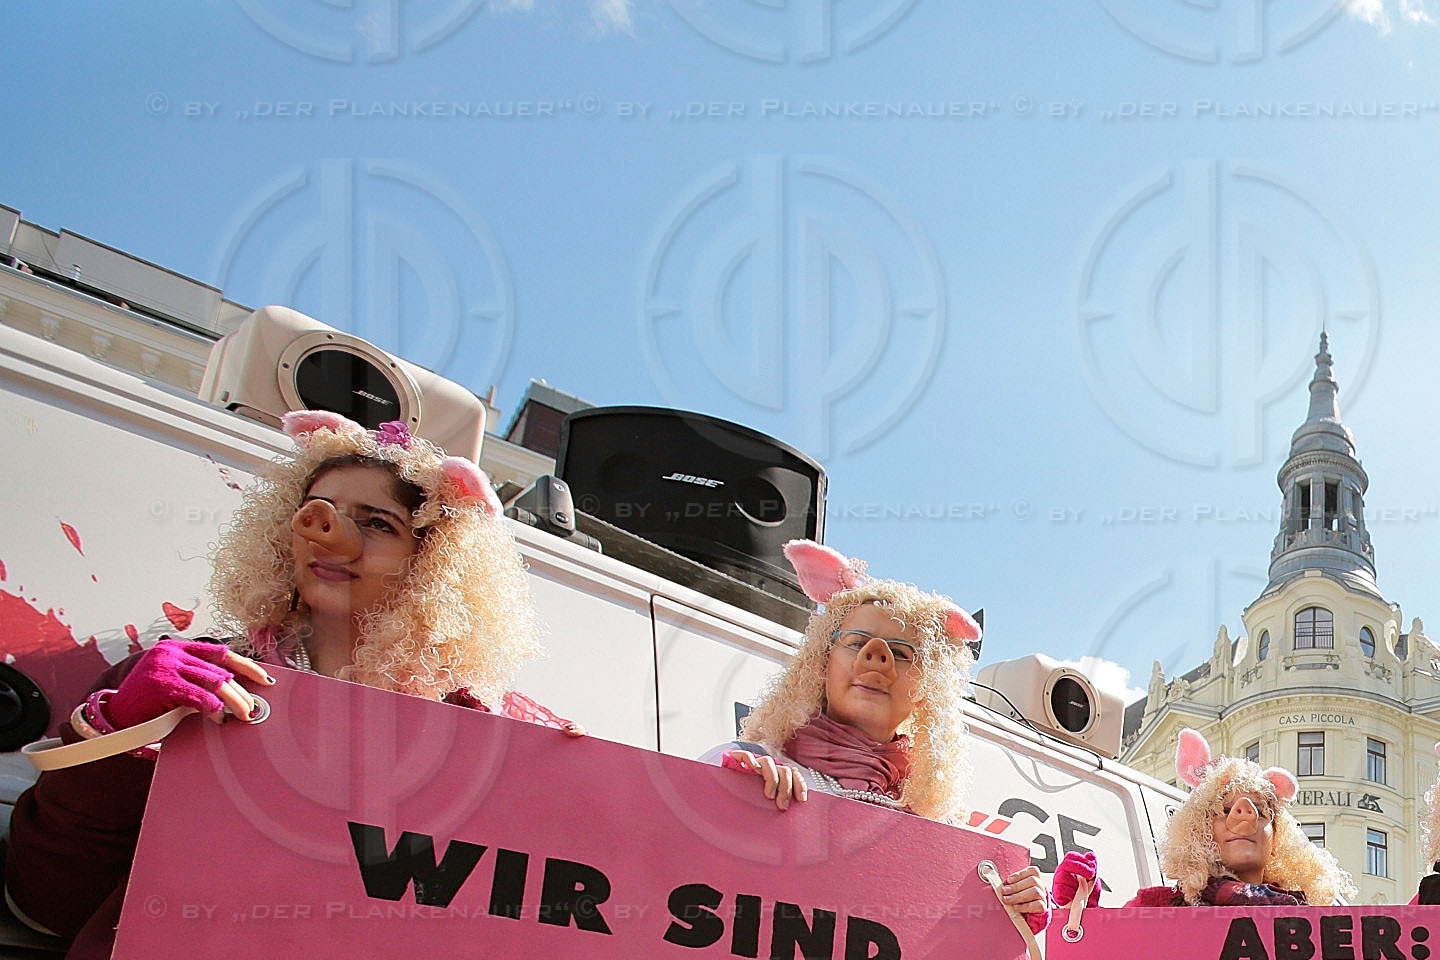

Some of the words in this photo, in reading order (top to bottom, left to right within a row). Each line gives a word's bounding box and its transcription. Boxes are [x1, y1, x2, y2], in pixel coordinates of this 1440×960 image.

[662, 473, 725, 488] BOSE
[1279, 715, 1306, 725] CASA
[1310, 713, 1355, 725] PICCOLA
[1293, 790, 1352, 808] NERALI
[347, 822, 612, 935] WIR
